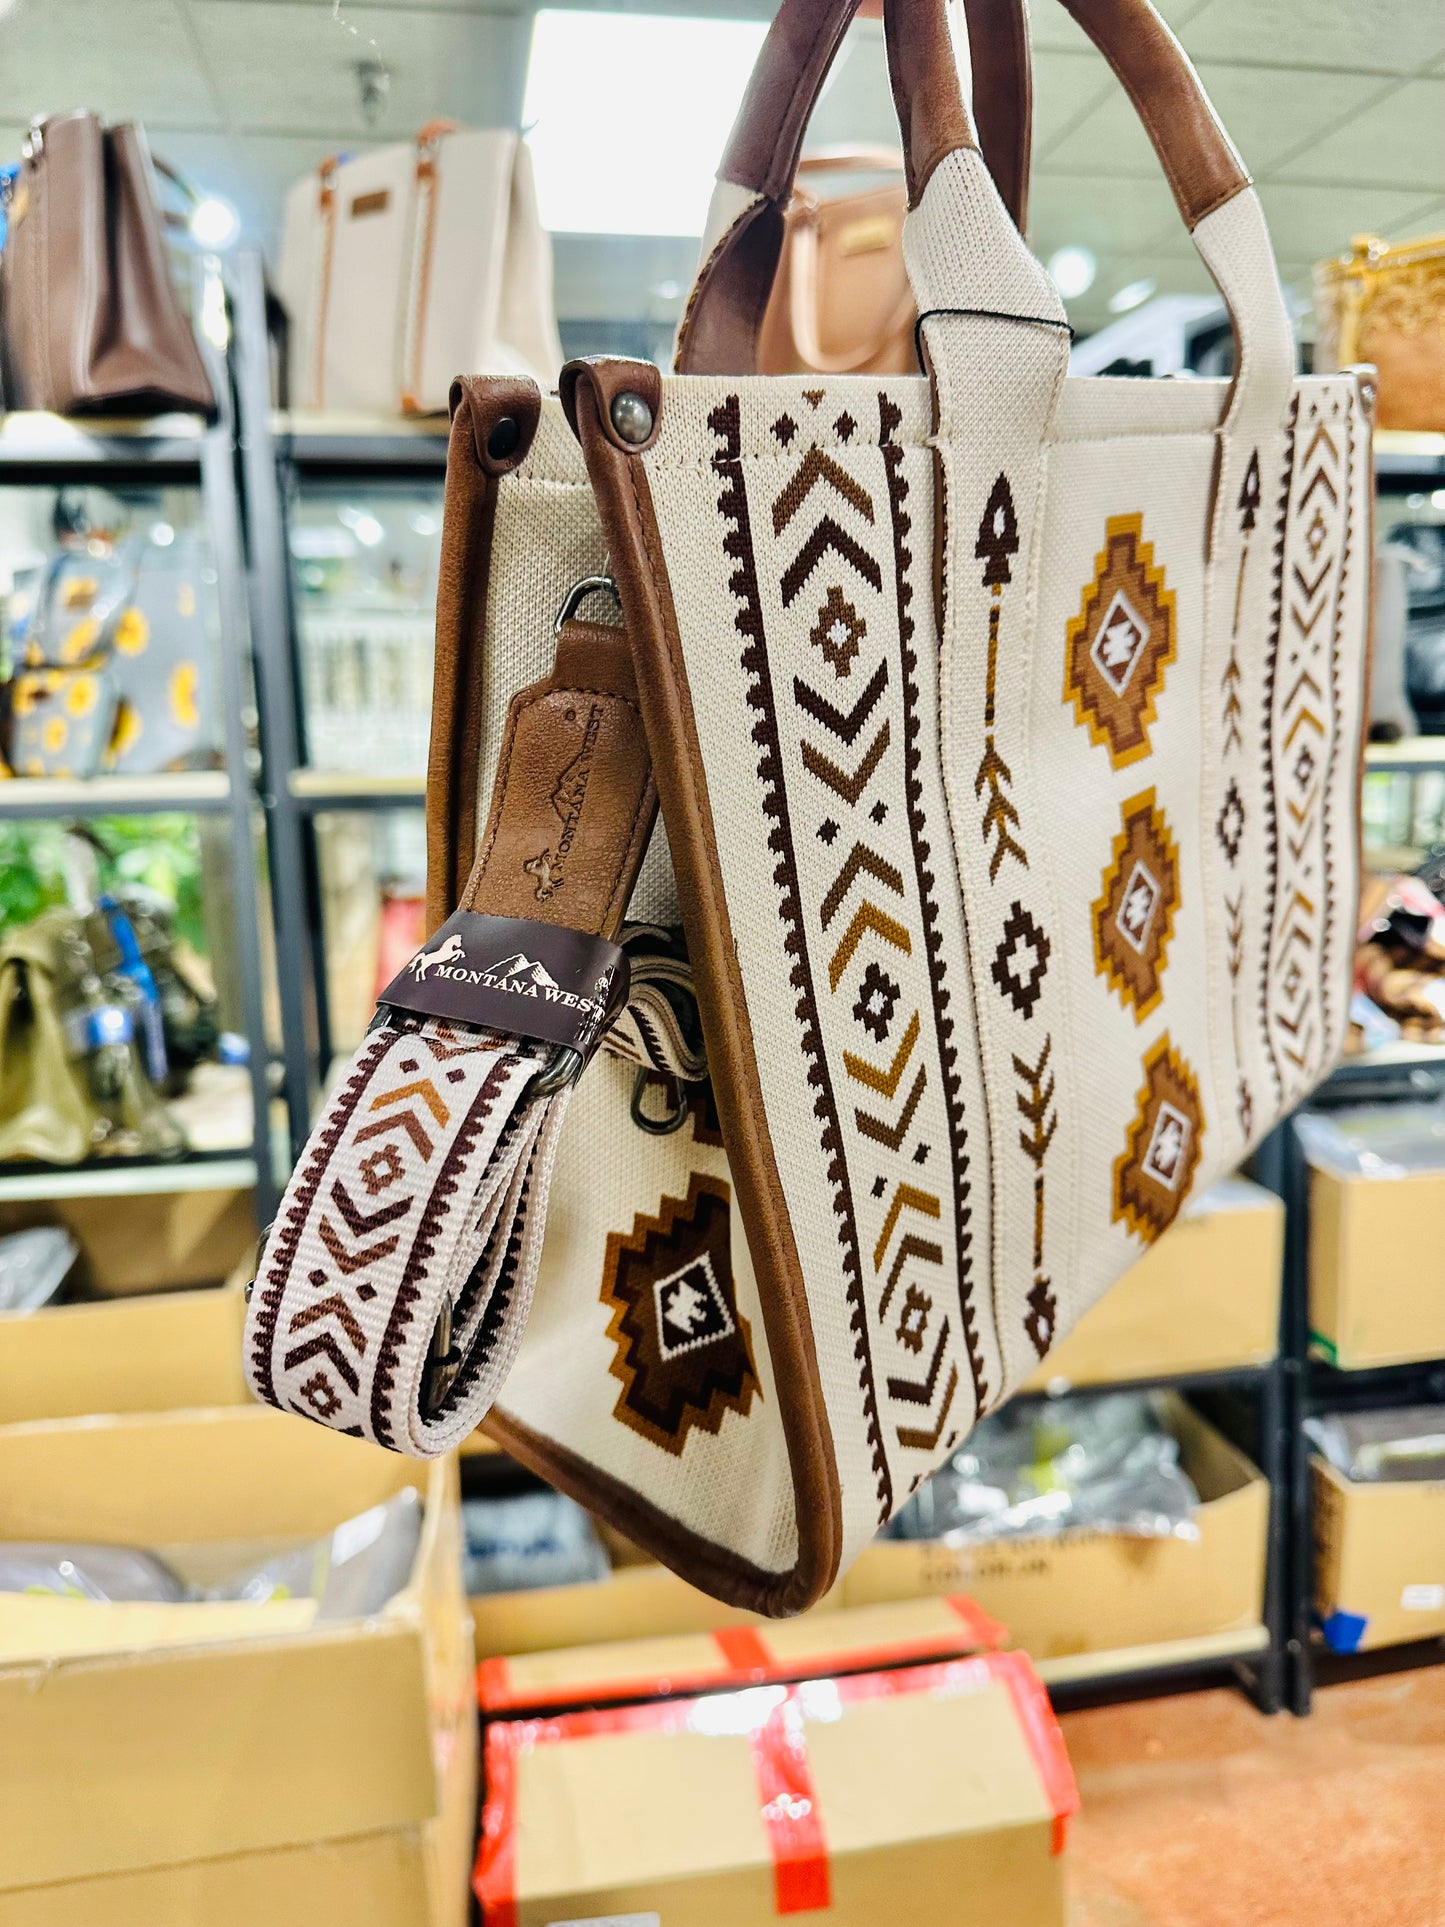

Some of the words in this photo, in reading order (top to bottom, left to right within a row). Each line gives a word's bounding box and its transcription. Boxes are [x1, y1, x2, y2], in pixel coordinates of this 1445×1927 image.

[551, 770, 590, 871] MONTANA
[582, 703, 604, 761] WEST
[434, 964, 538, 998] MONTANA
[545, 986, 606, 1022] WEST
